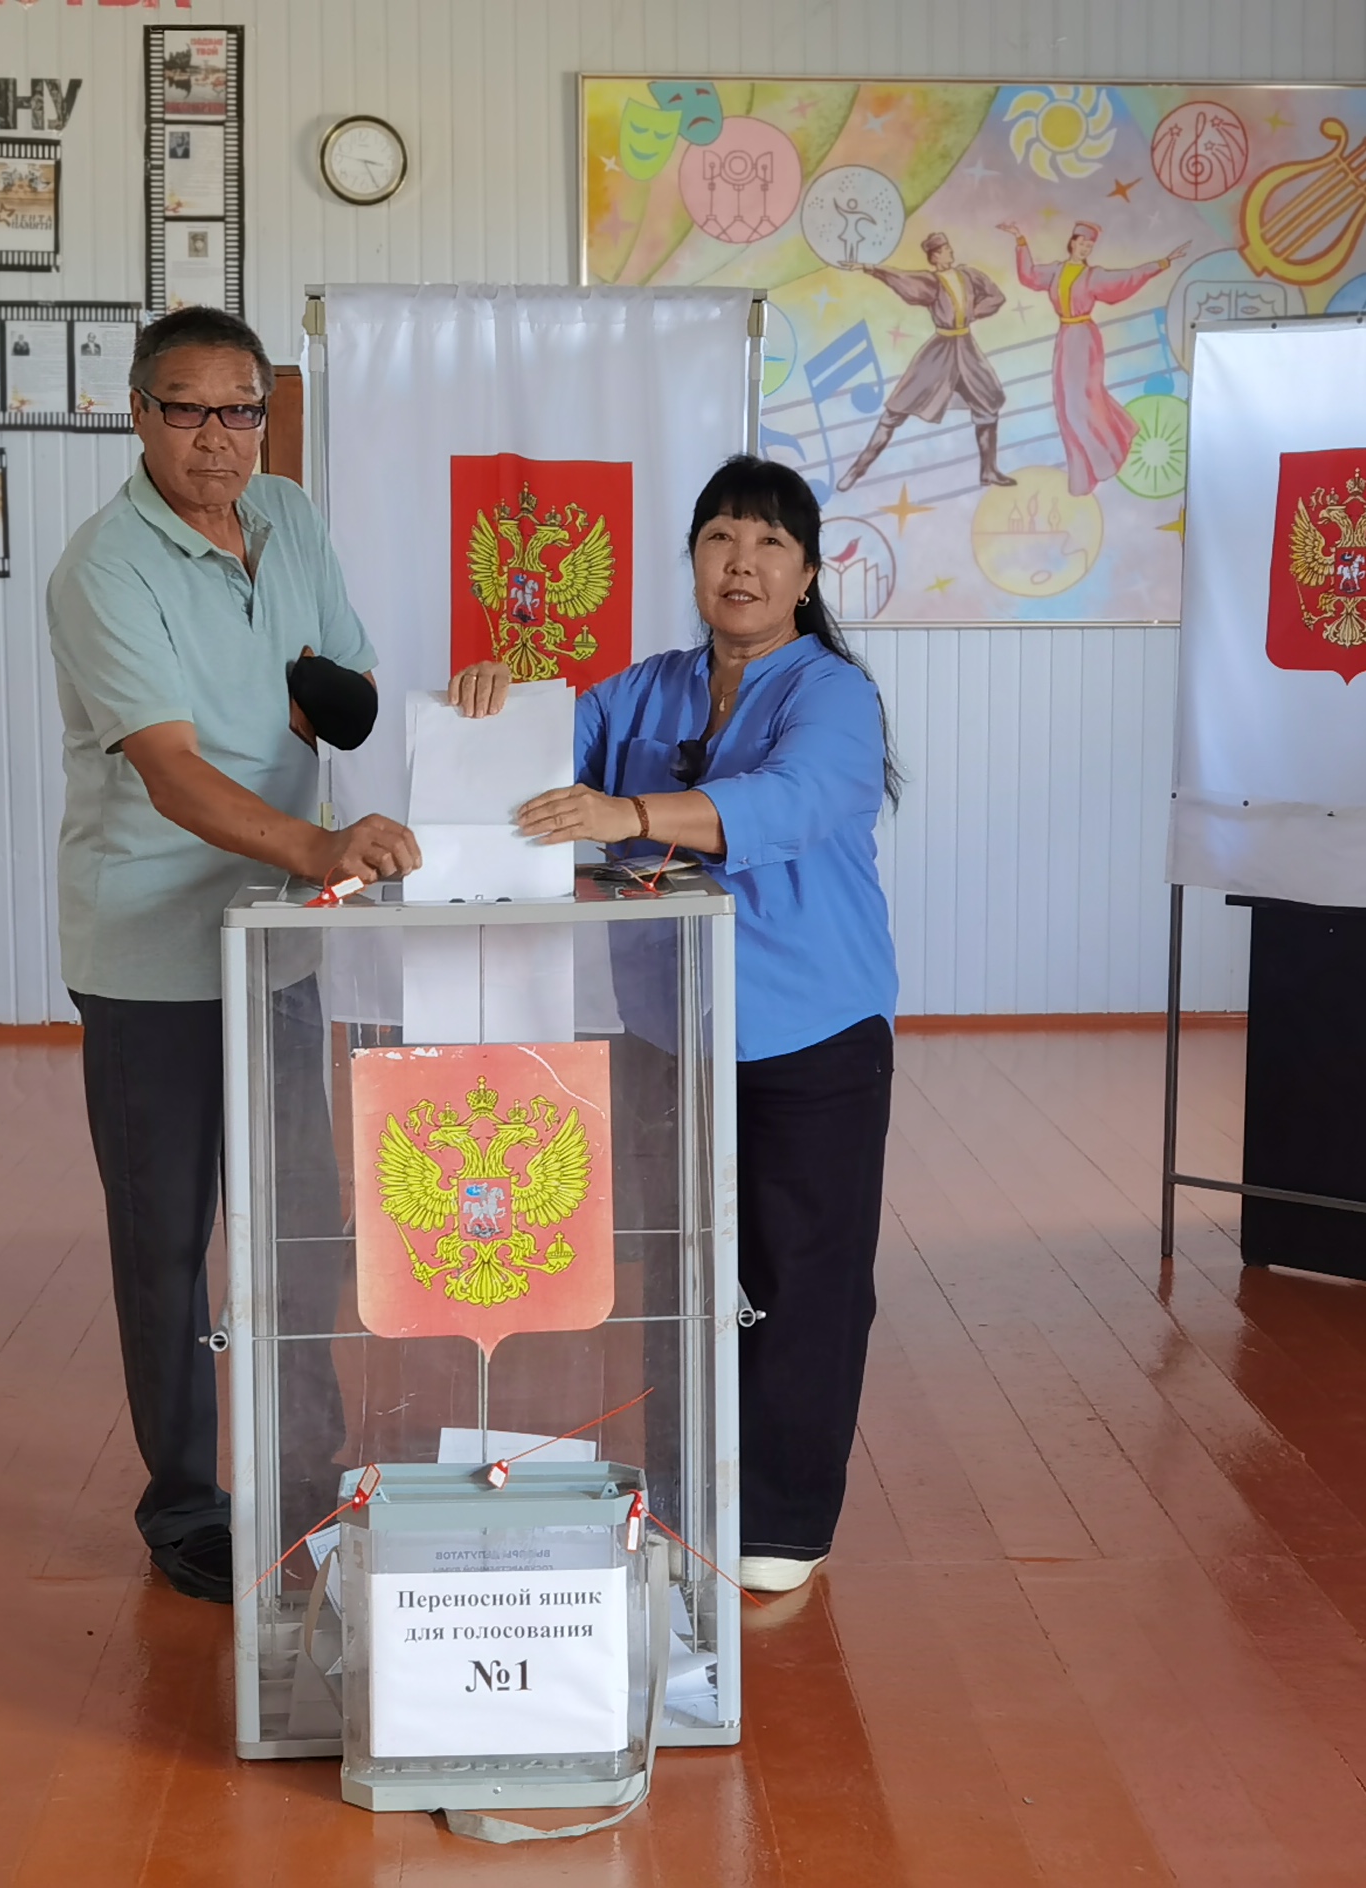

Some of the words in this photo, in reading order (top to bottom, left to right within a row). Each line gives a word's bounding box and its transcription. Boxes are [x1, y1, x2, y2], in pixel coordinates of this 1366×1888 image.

[397, 1588, 531, 1612] Переносной
[539, 1590, 603, 1608] ящик
[404, 1627, 445, 1643] для
[452, 1624, 594, 1640] голосования
[465, 1659, 533, 1693] №1
